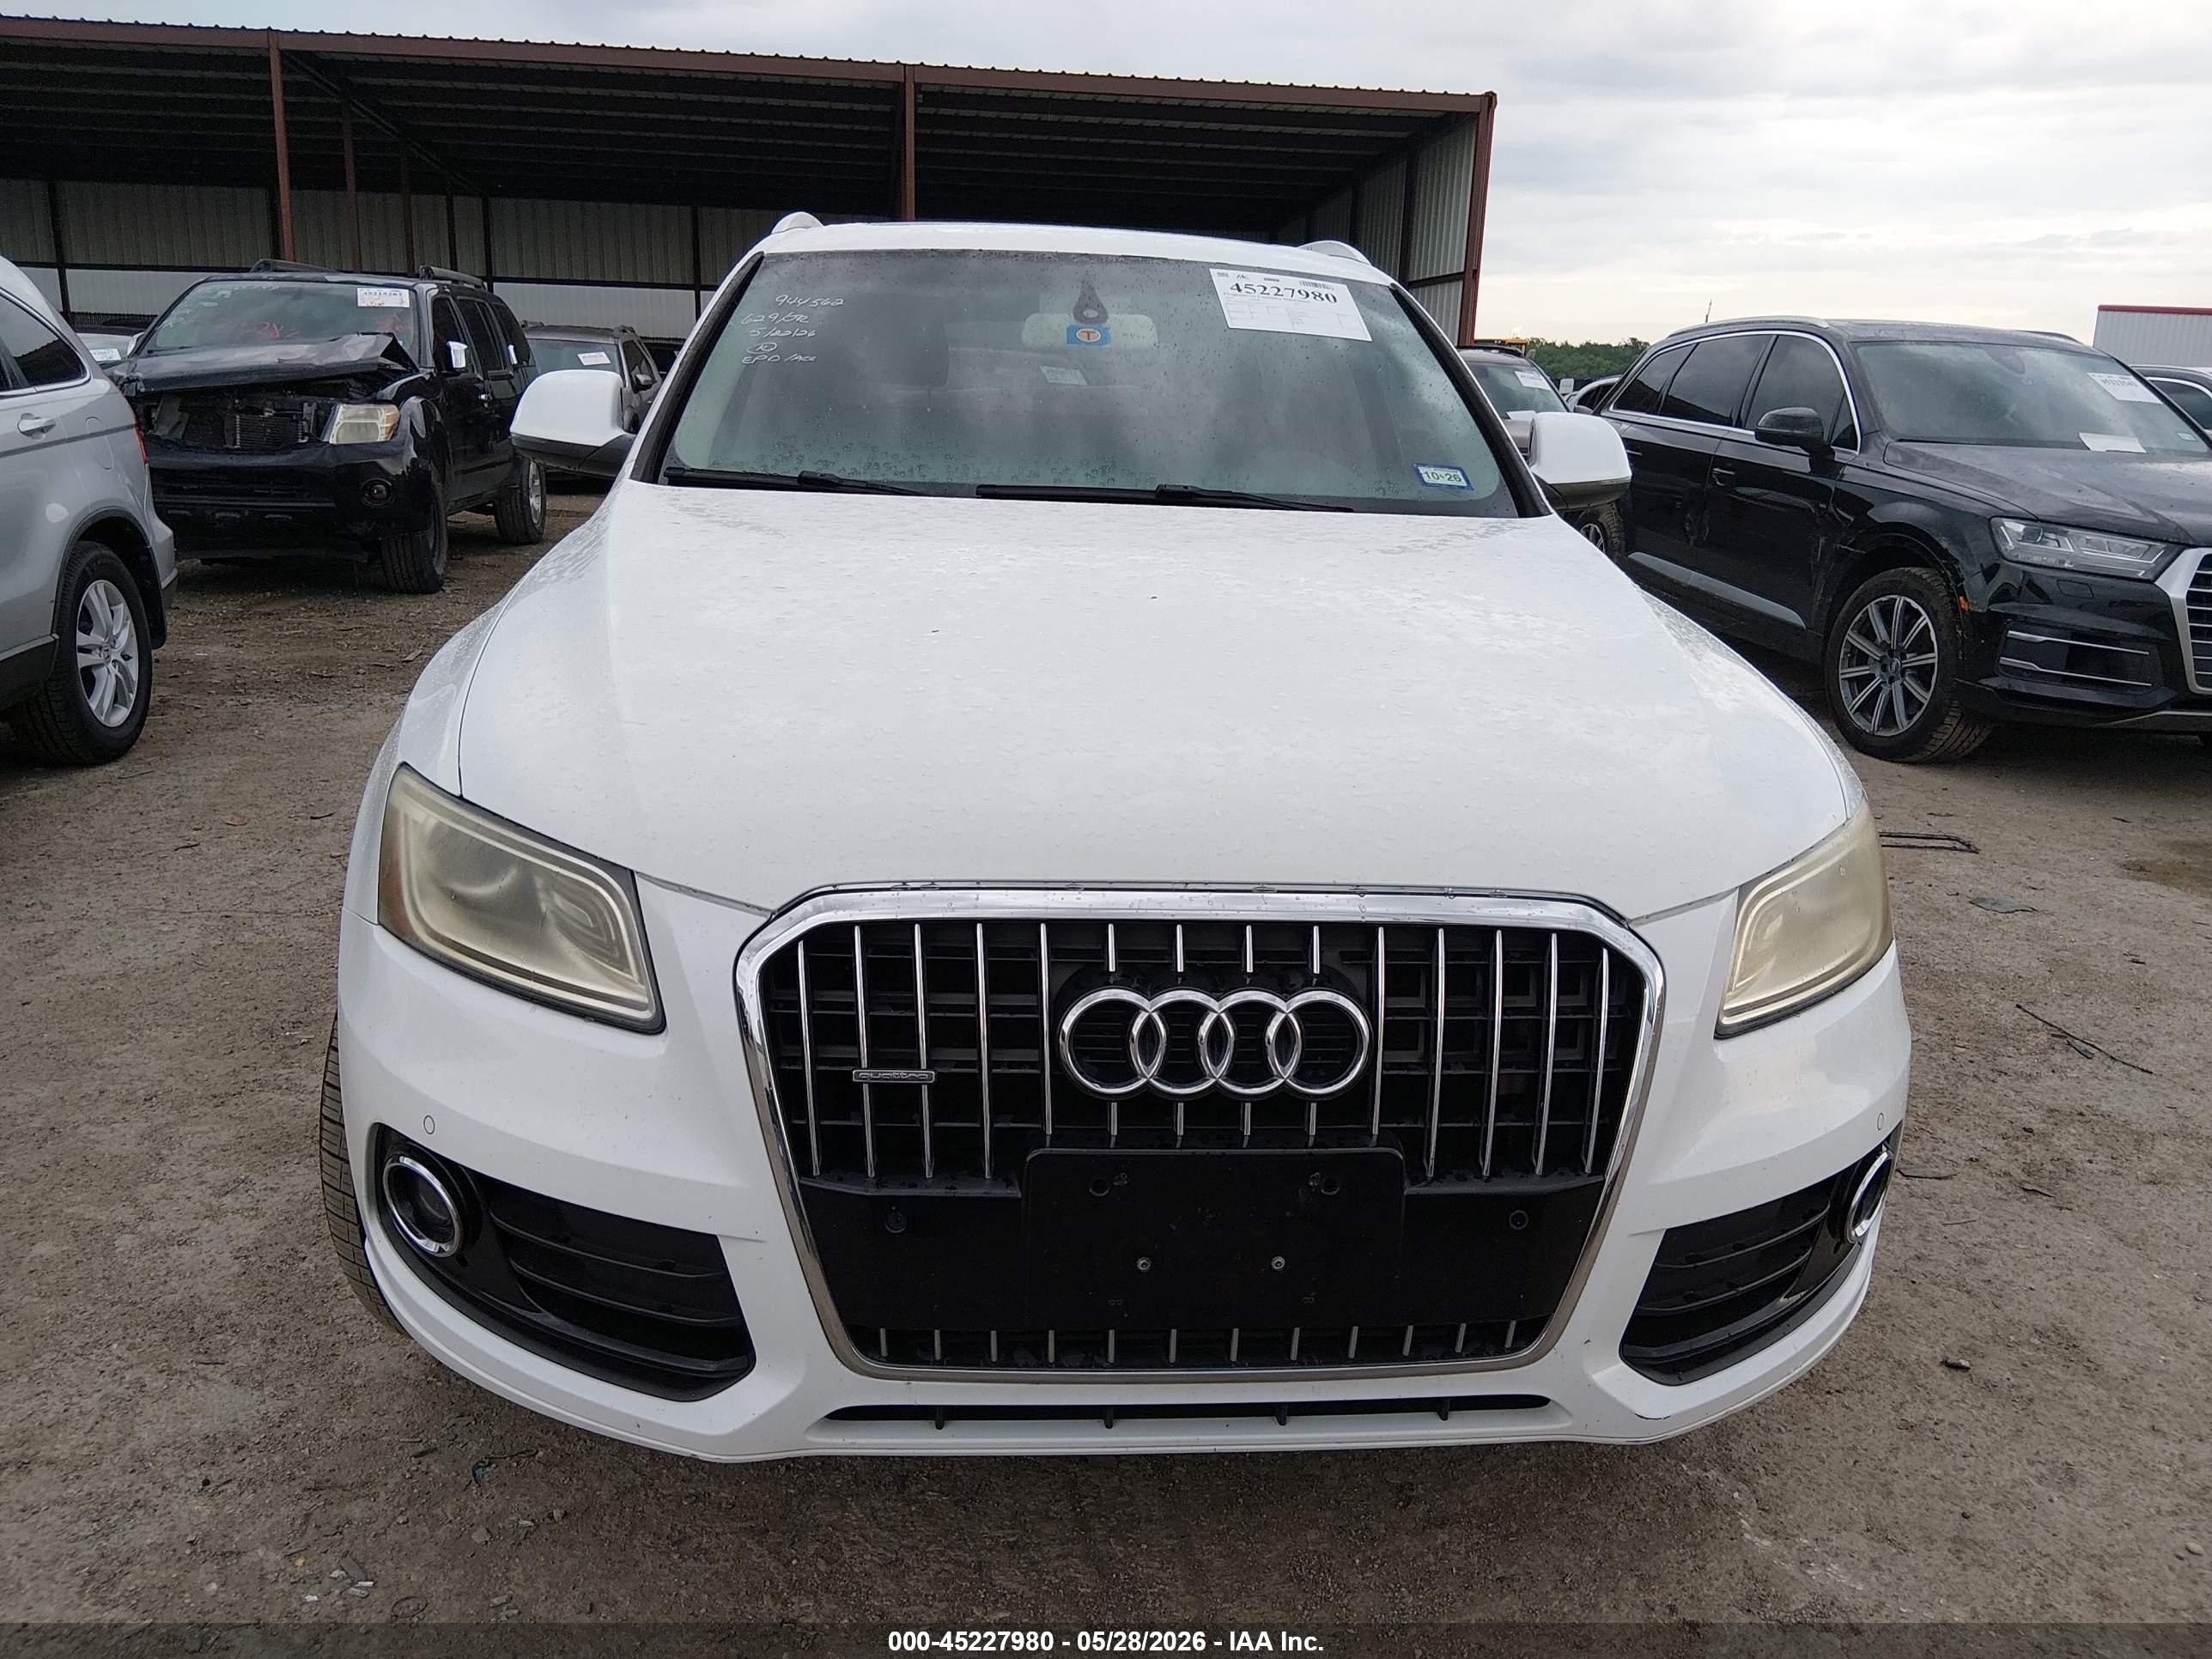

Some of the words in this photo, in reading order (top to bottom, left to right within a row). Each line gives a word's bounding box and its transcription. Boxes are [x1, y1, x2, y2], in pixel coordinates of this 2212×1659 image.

[1230, 283, 1338, 303] 45227980
[775, 294, 845, 307] 944562
[859, 1072, 929, 1080] quattro
